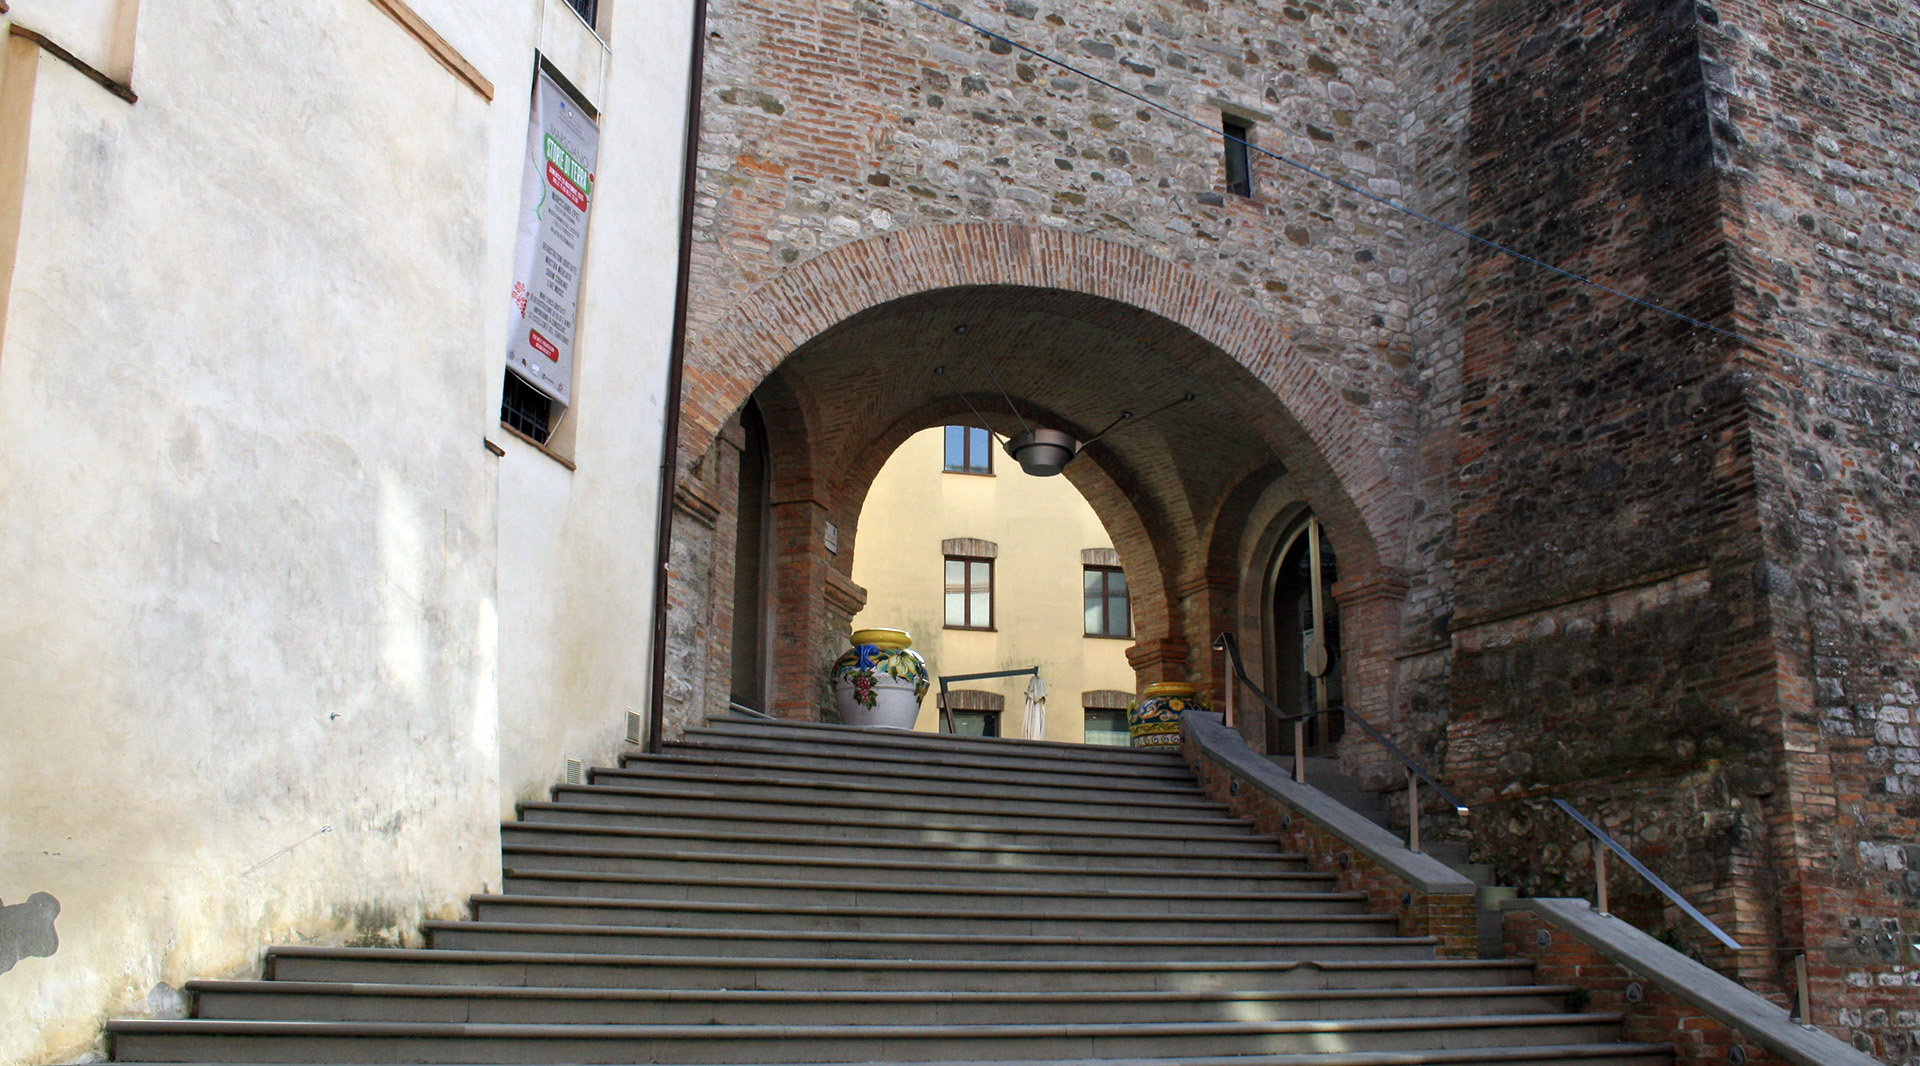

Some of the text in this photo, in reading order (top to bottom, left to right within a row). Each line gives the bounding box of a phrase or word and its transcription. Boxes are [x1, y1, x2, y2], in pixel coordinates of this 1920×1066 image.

[547, 137, 564, 170] STORIE
[564, 154, 570, 176] DI
[569, 159, 587, 191] TERRA
